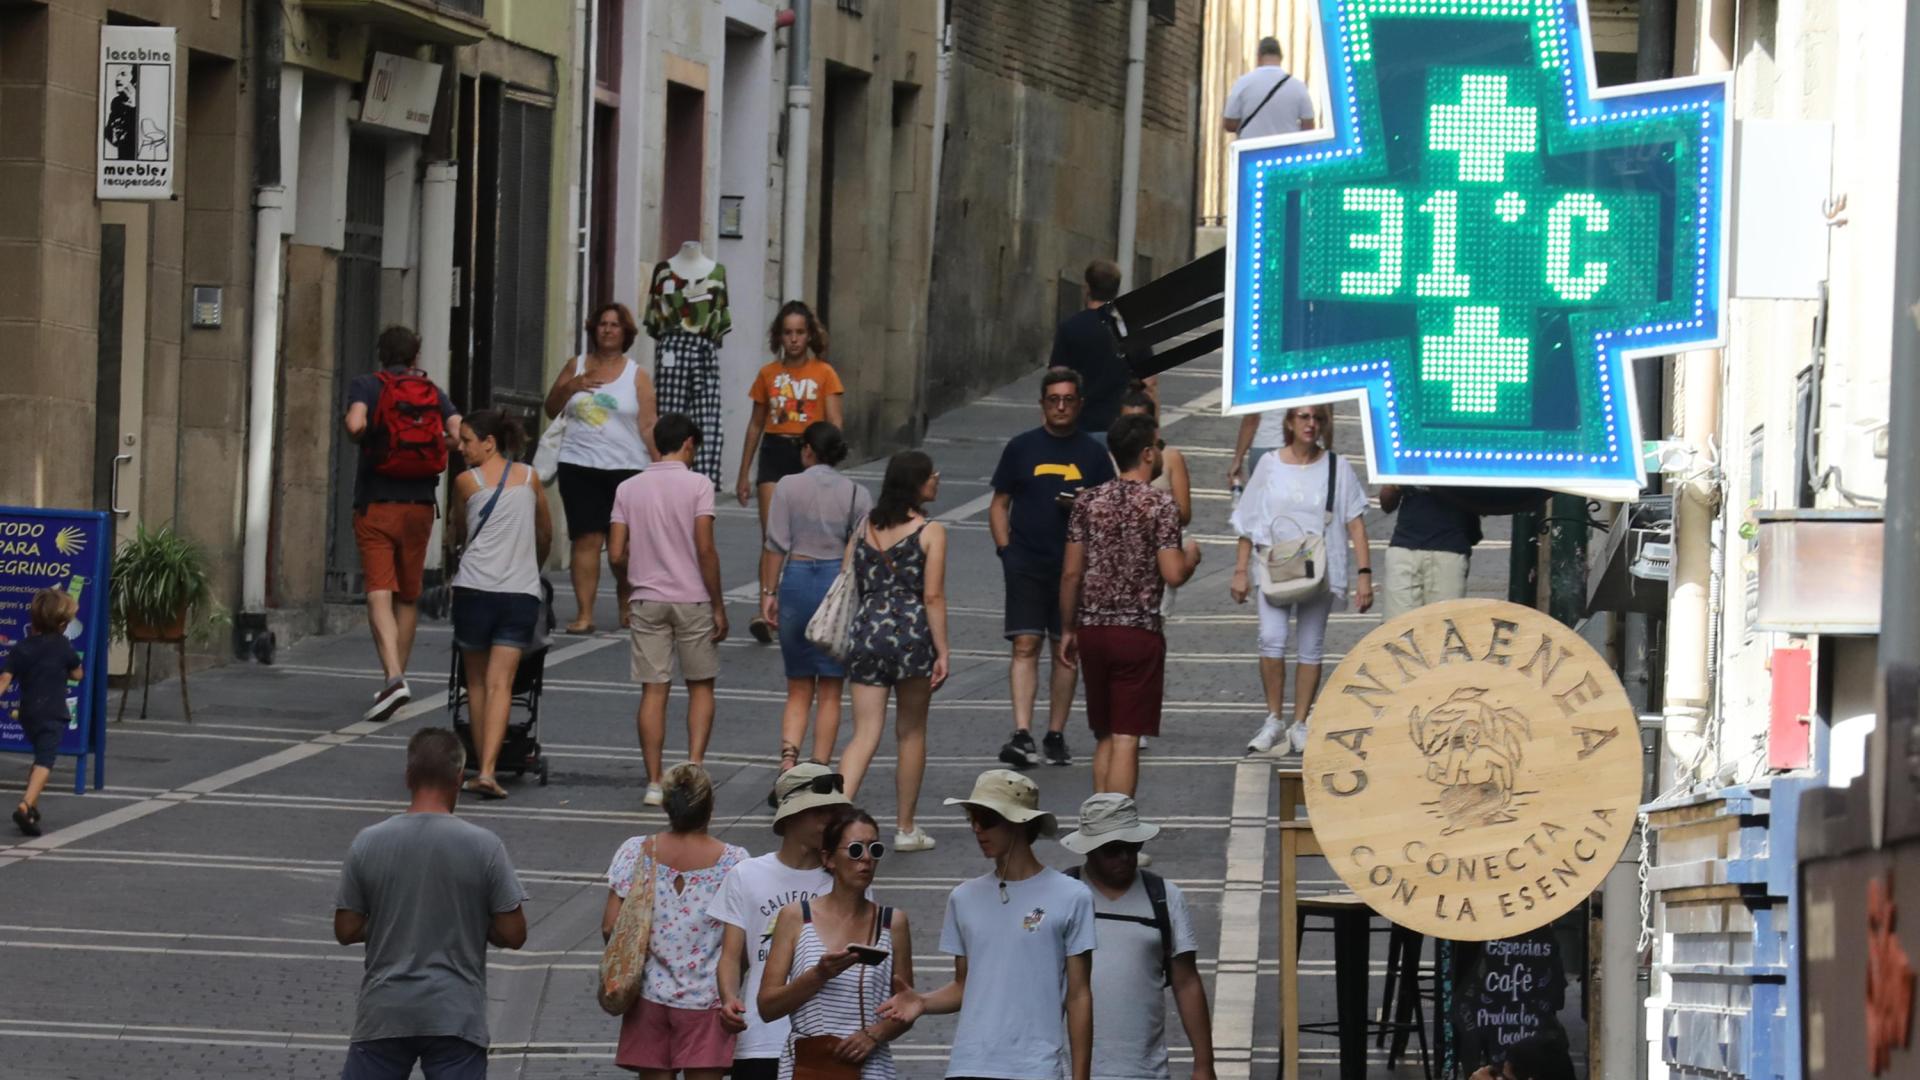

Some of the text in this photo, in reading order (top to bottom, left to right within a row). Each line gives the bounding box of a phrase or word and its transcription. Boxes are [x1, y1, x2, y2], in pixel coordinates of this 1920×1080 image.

[103, 164, 168, 177] muebles
[103, 176, 168, 189] recuperados
[1321, 617, 1620, 797] CANNAENEA
[1350, 805, 1617, 922] CON LA ESENCIA
[1402, 820, 1567, 882] CONECTA
